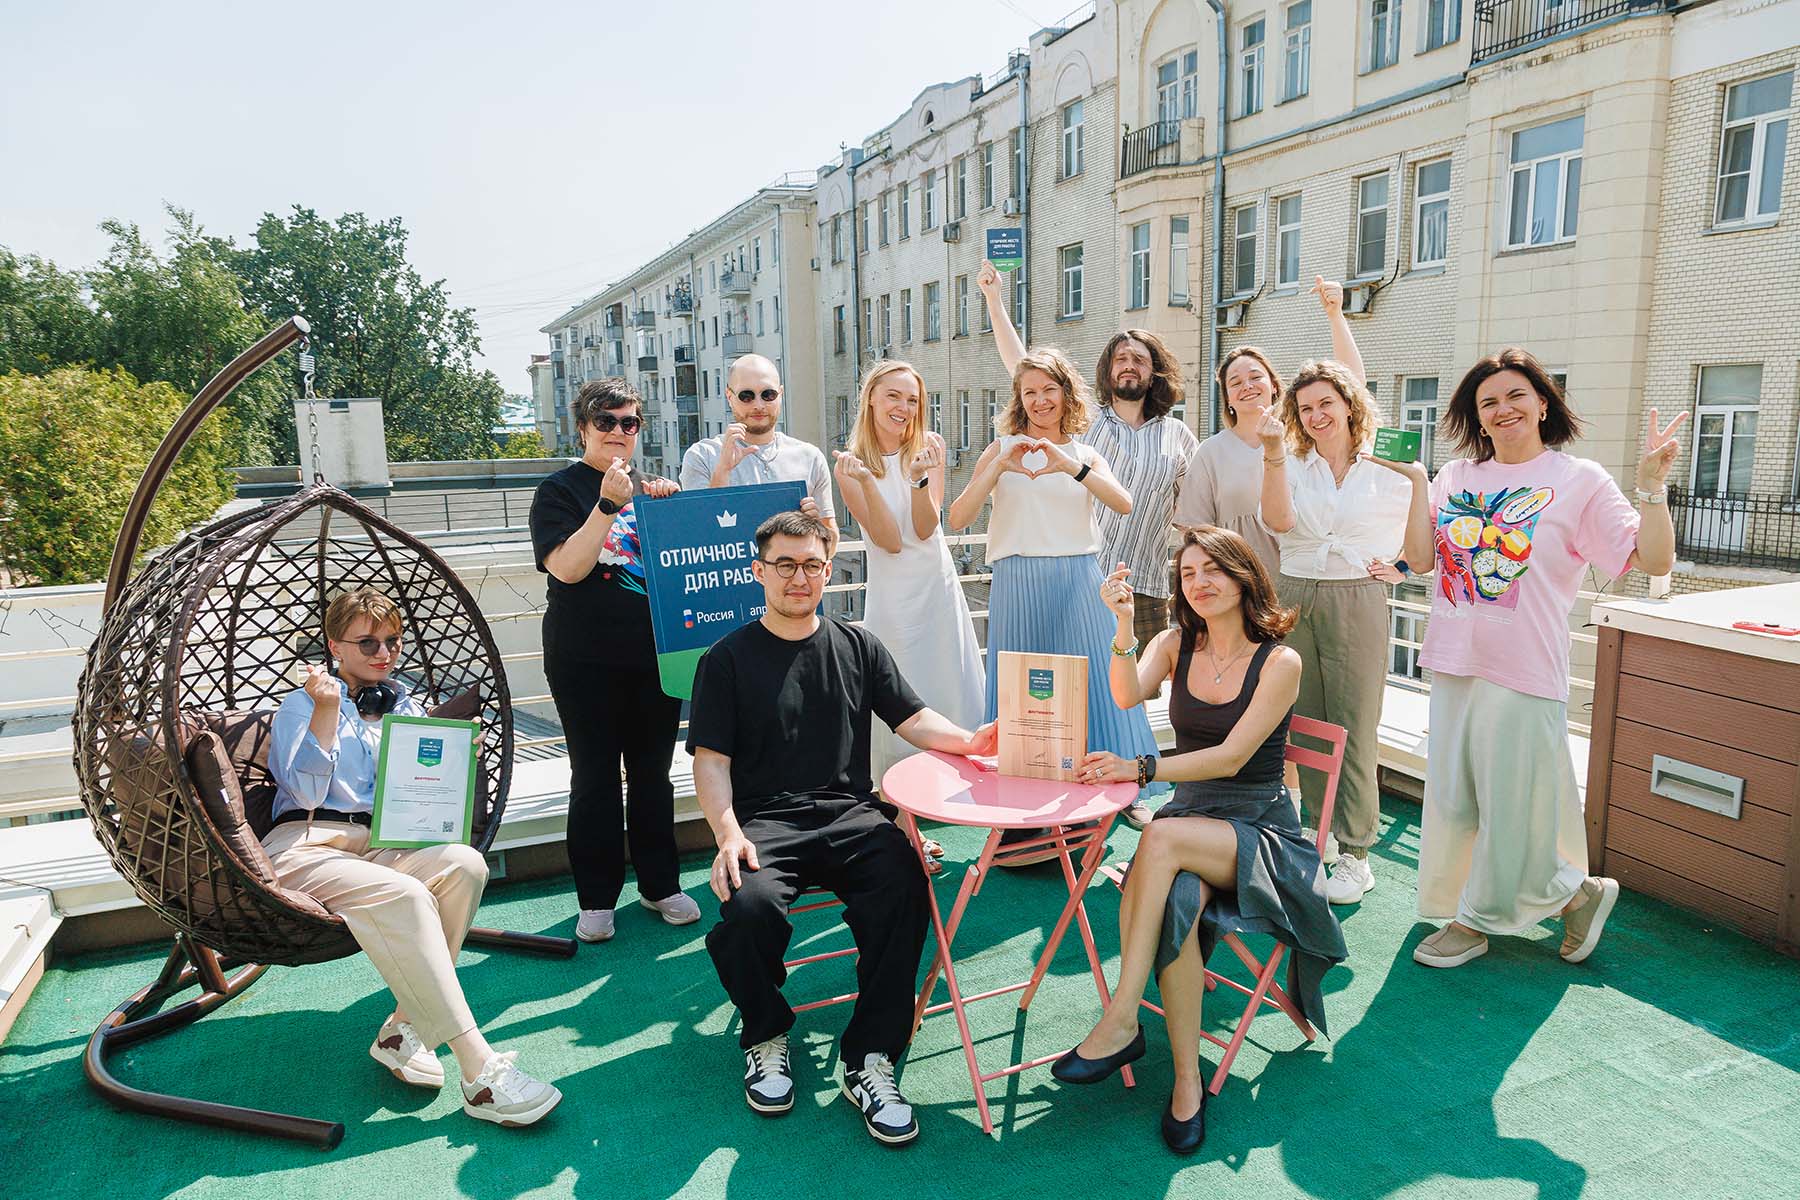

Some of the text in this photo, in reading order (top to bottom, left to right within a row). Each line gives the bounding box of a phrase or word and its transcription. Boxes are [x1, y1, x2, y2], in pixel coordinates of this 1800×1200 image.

[659, 542, 747, 568] ОТЛИЧНОЕ
[684, 567, 759, 595] ДЛЯ РАБ
[696, 610, 735, 624] Россия
